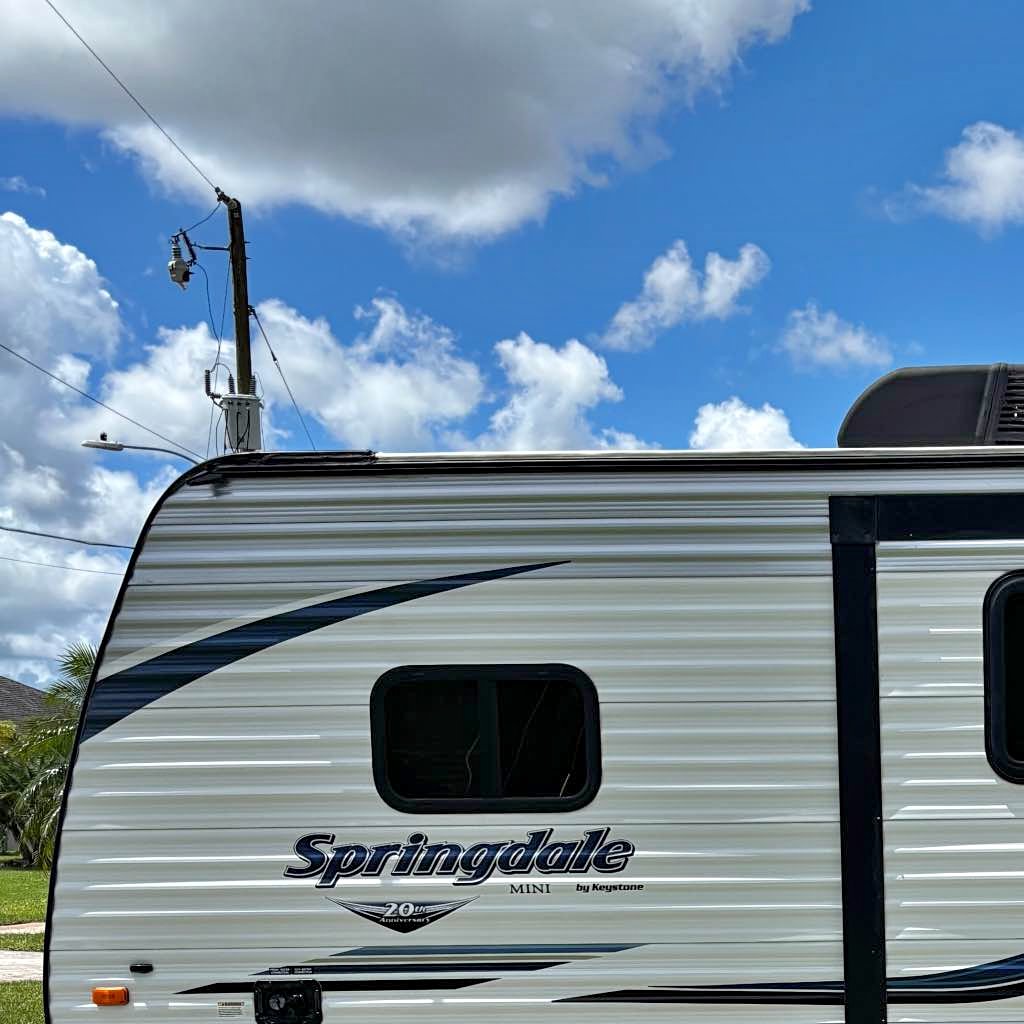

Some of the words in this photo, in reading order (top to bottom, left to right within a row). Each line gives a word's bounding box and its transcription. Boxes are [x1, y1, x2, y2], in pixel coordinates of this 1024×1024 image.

[284, 826, 636, 888] Springdale
[510, 885, 551, 894] MINI
[576, 884, 589, 893] by
[591, 883, 645, 893] Keystone
